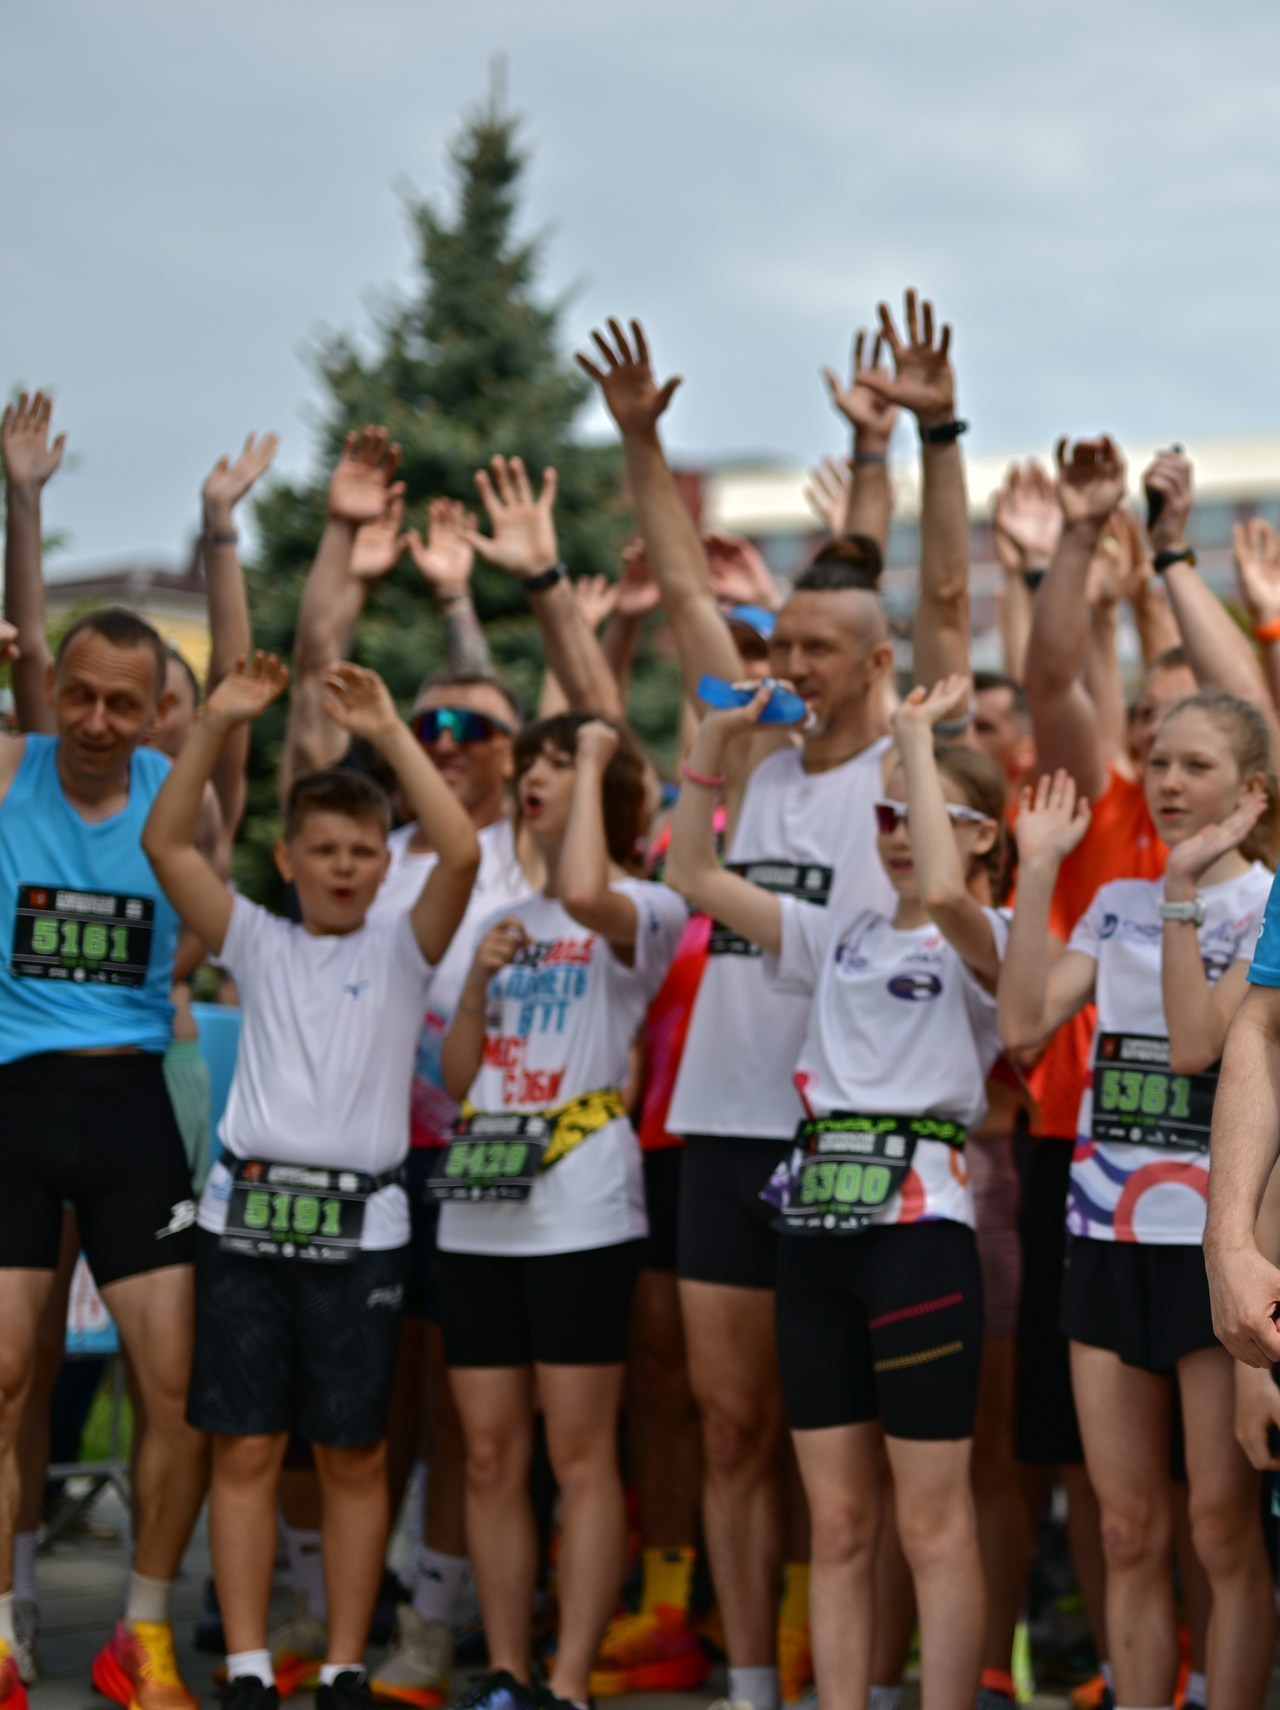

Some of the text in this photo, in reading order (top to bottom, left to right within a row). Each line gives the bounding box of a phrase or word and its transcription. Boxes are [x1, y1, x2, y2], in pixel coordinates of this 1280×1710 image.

[32, 916, 129, 962] 5161
[1102, 1069, 1190, 1117] 5361
[801, 1162, 891, 1205] 5300
[244, 1190, 341, 1236] 5191
